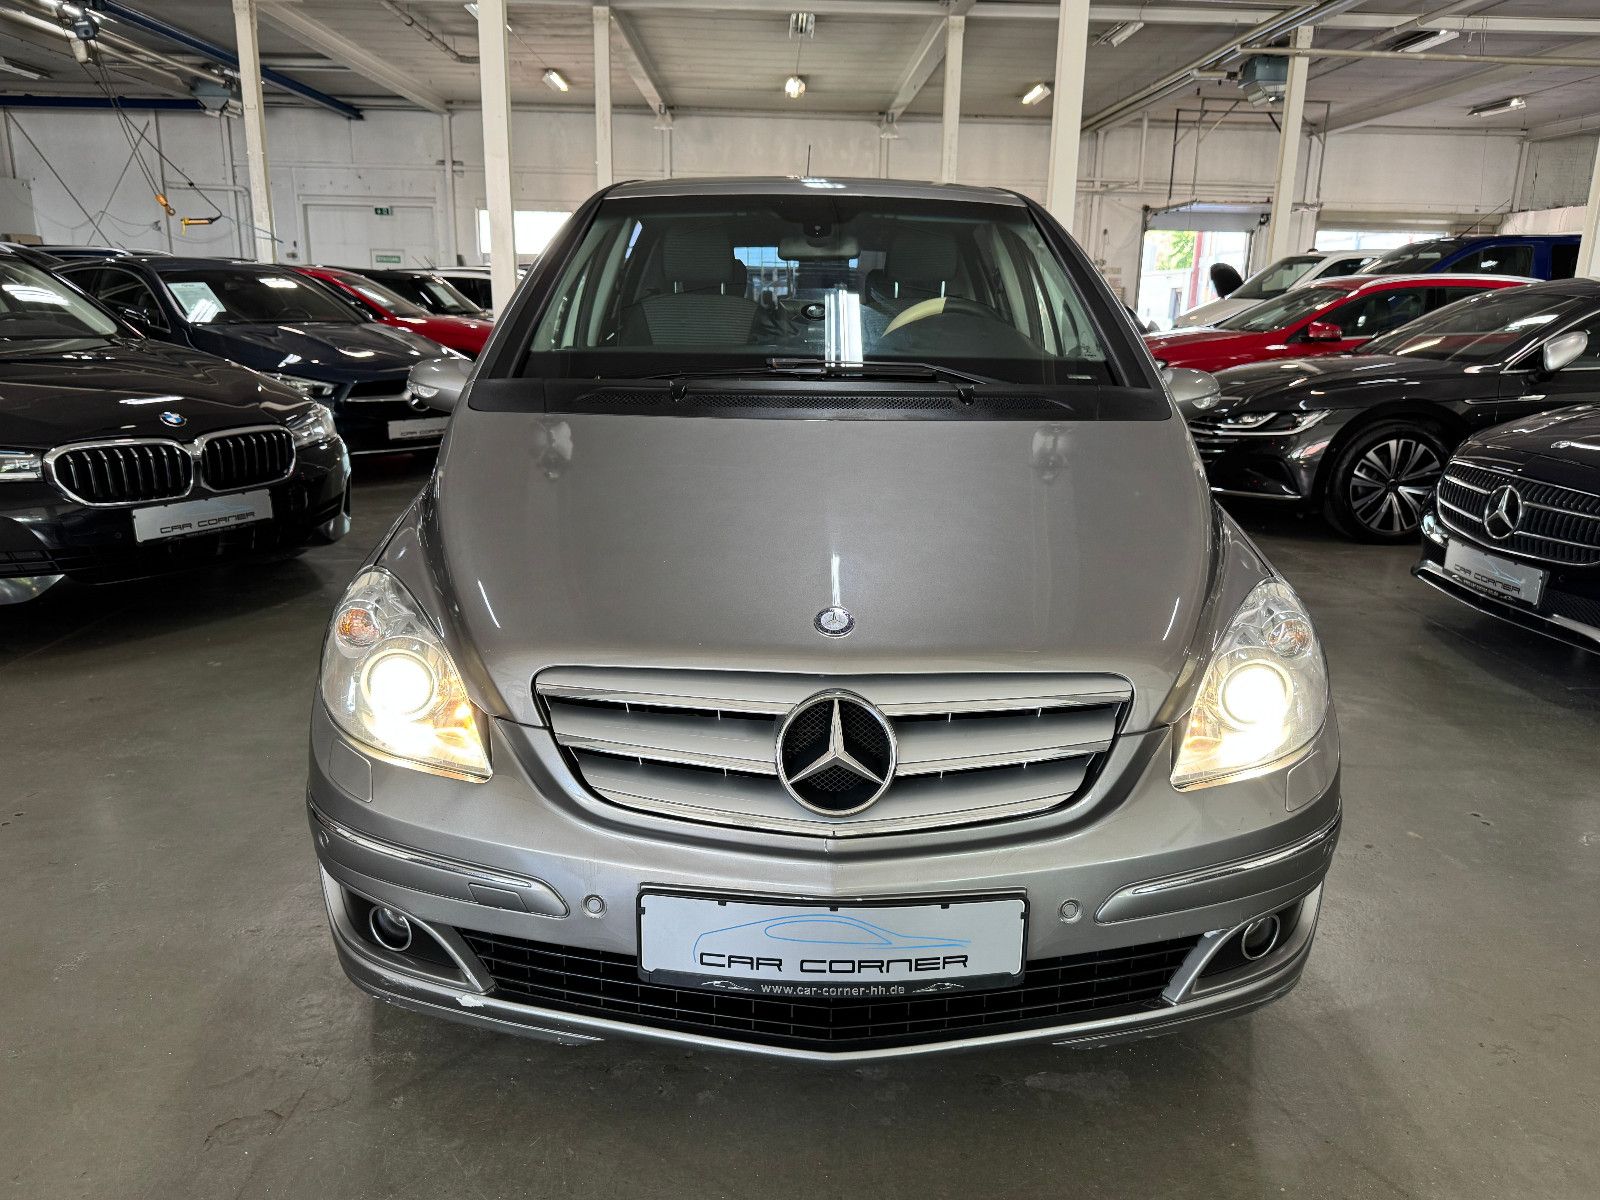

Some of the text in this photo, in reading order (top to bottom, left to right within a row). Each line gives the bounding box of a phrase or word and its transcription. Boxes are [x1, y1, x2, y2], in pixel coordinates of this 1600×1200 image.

[160, 522, 192, 533] CAR
[197, 511, 256, 527] CORNER
[1454, 563, 1471, 577] CAR
[1474, 572, 1521, 594] CORNER
[699, 952, 969, 974] CAR CORNER
[760, 984, 905, 997] www.car-corner-hh.de
